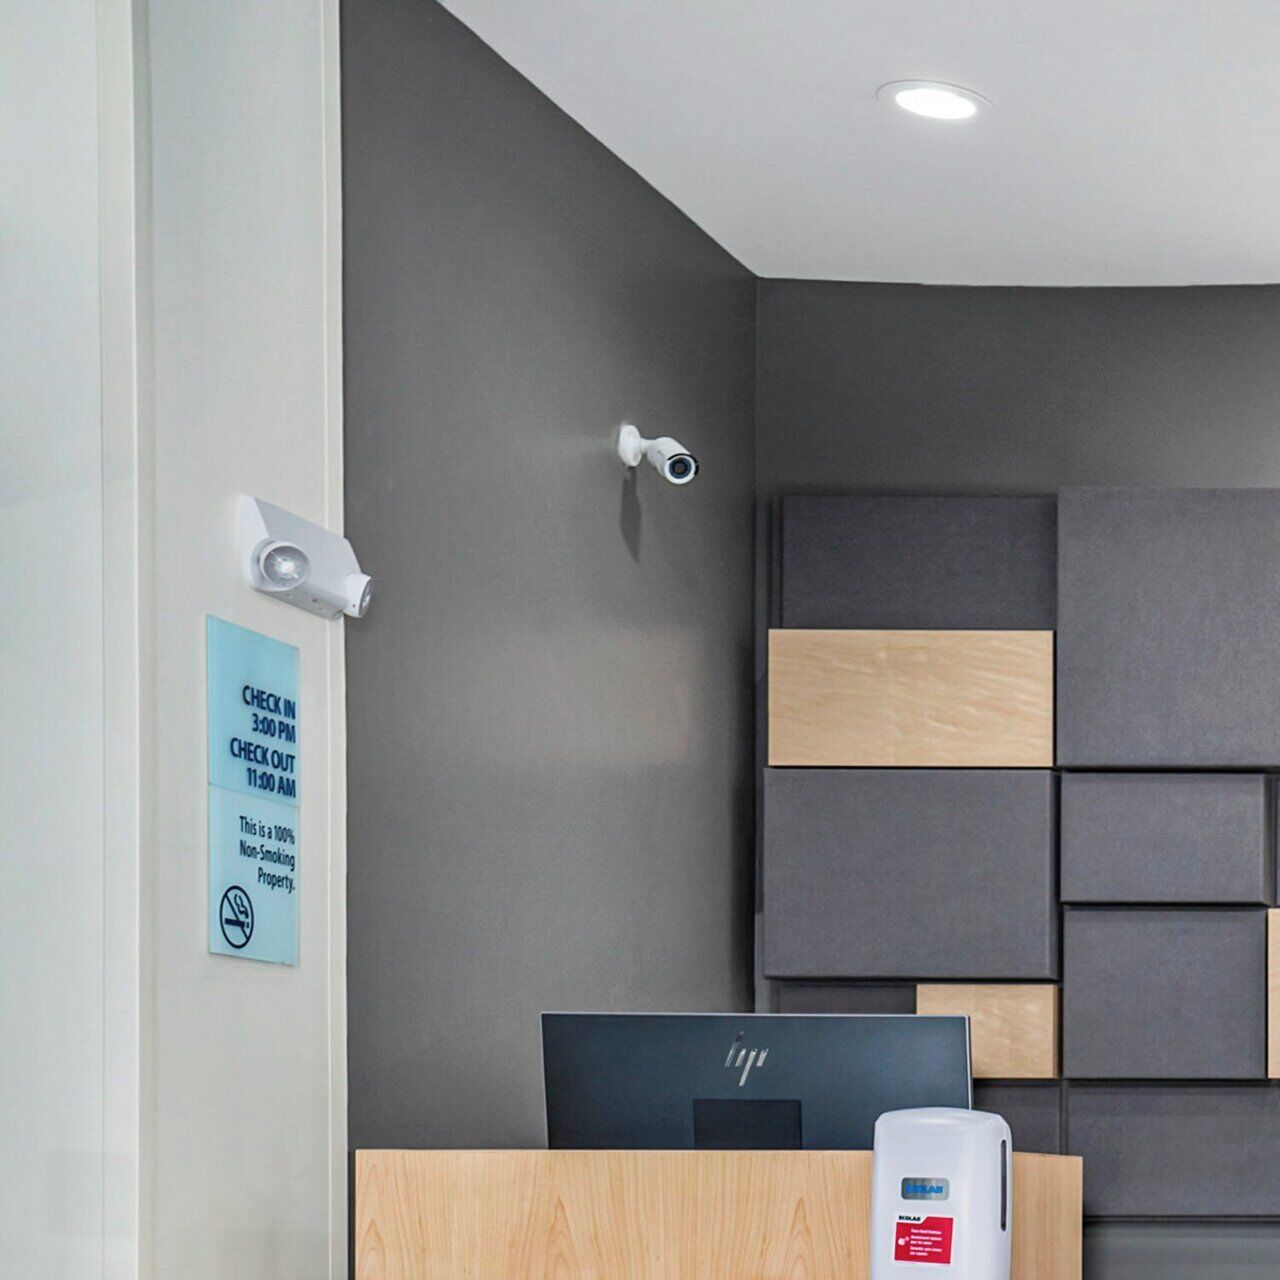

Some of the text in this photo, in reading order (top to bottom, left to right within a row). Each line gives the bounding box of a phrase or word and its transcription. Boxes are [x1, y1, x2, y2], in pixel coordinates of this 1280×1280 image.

[242, 684, 296, 720] CHECK IN
[252, 712, 296, 744] 3:00 PM
[230, 737, 296, 774] CHECK OUT
[246, 767, 296, 798] 11:00 AM
[239, 815, 296, 845] This is a 100%
[239, 839, 296, 873] Non-Smoking
[258, 866, 296, 894] Property.
[724, 1031, 769, 1087] hp
[906, 1184, 943, 1194] ECOLAB
